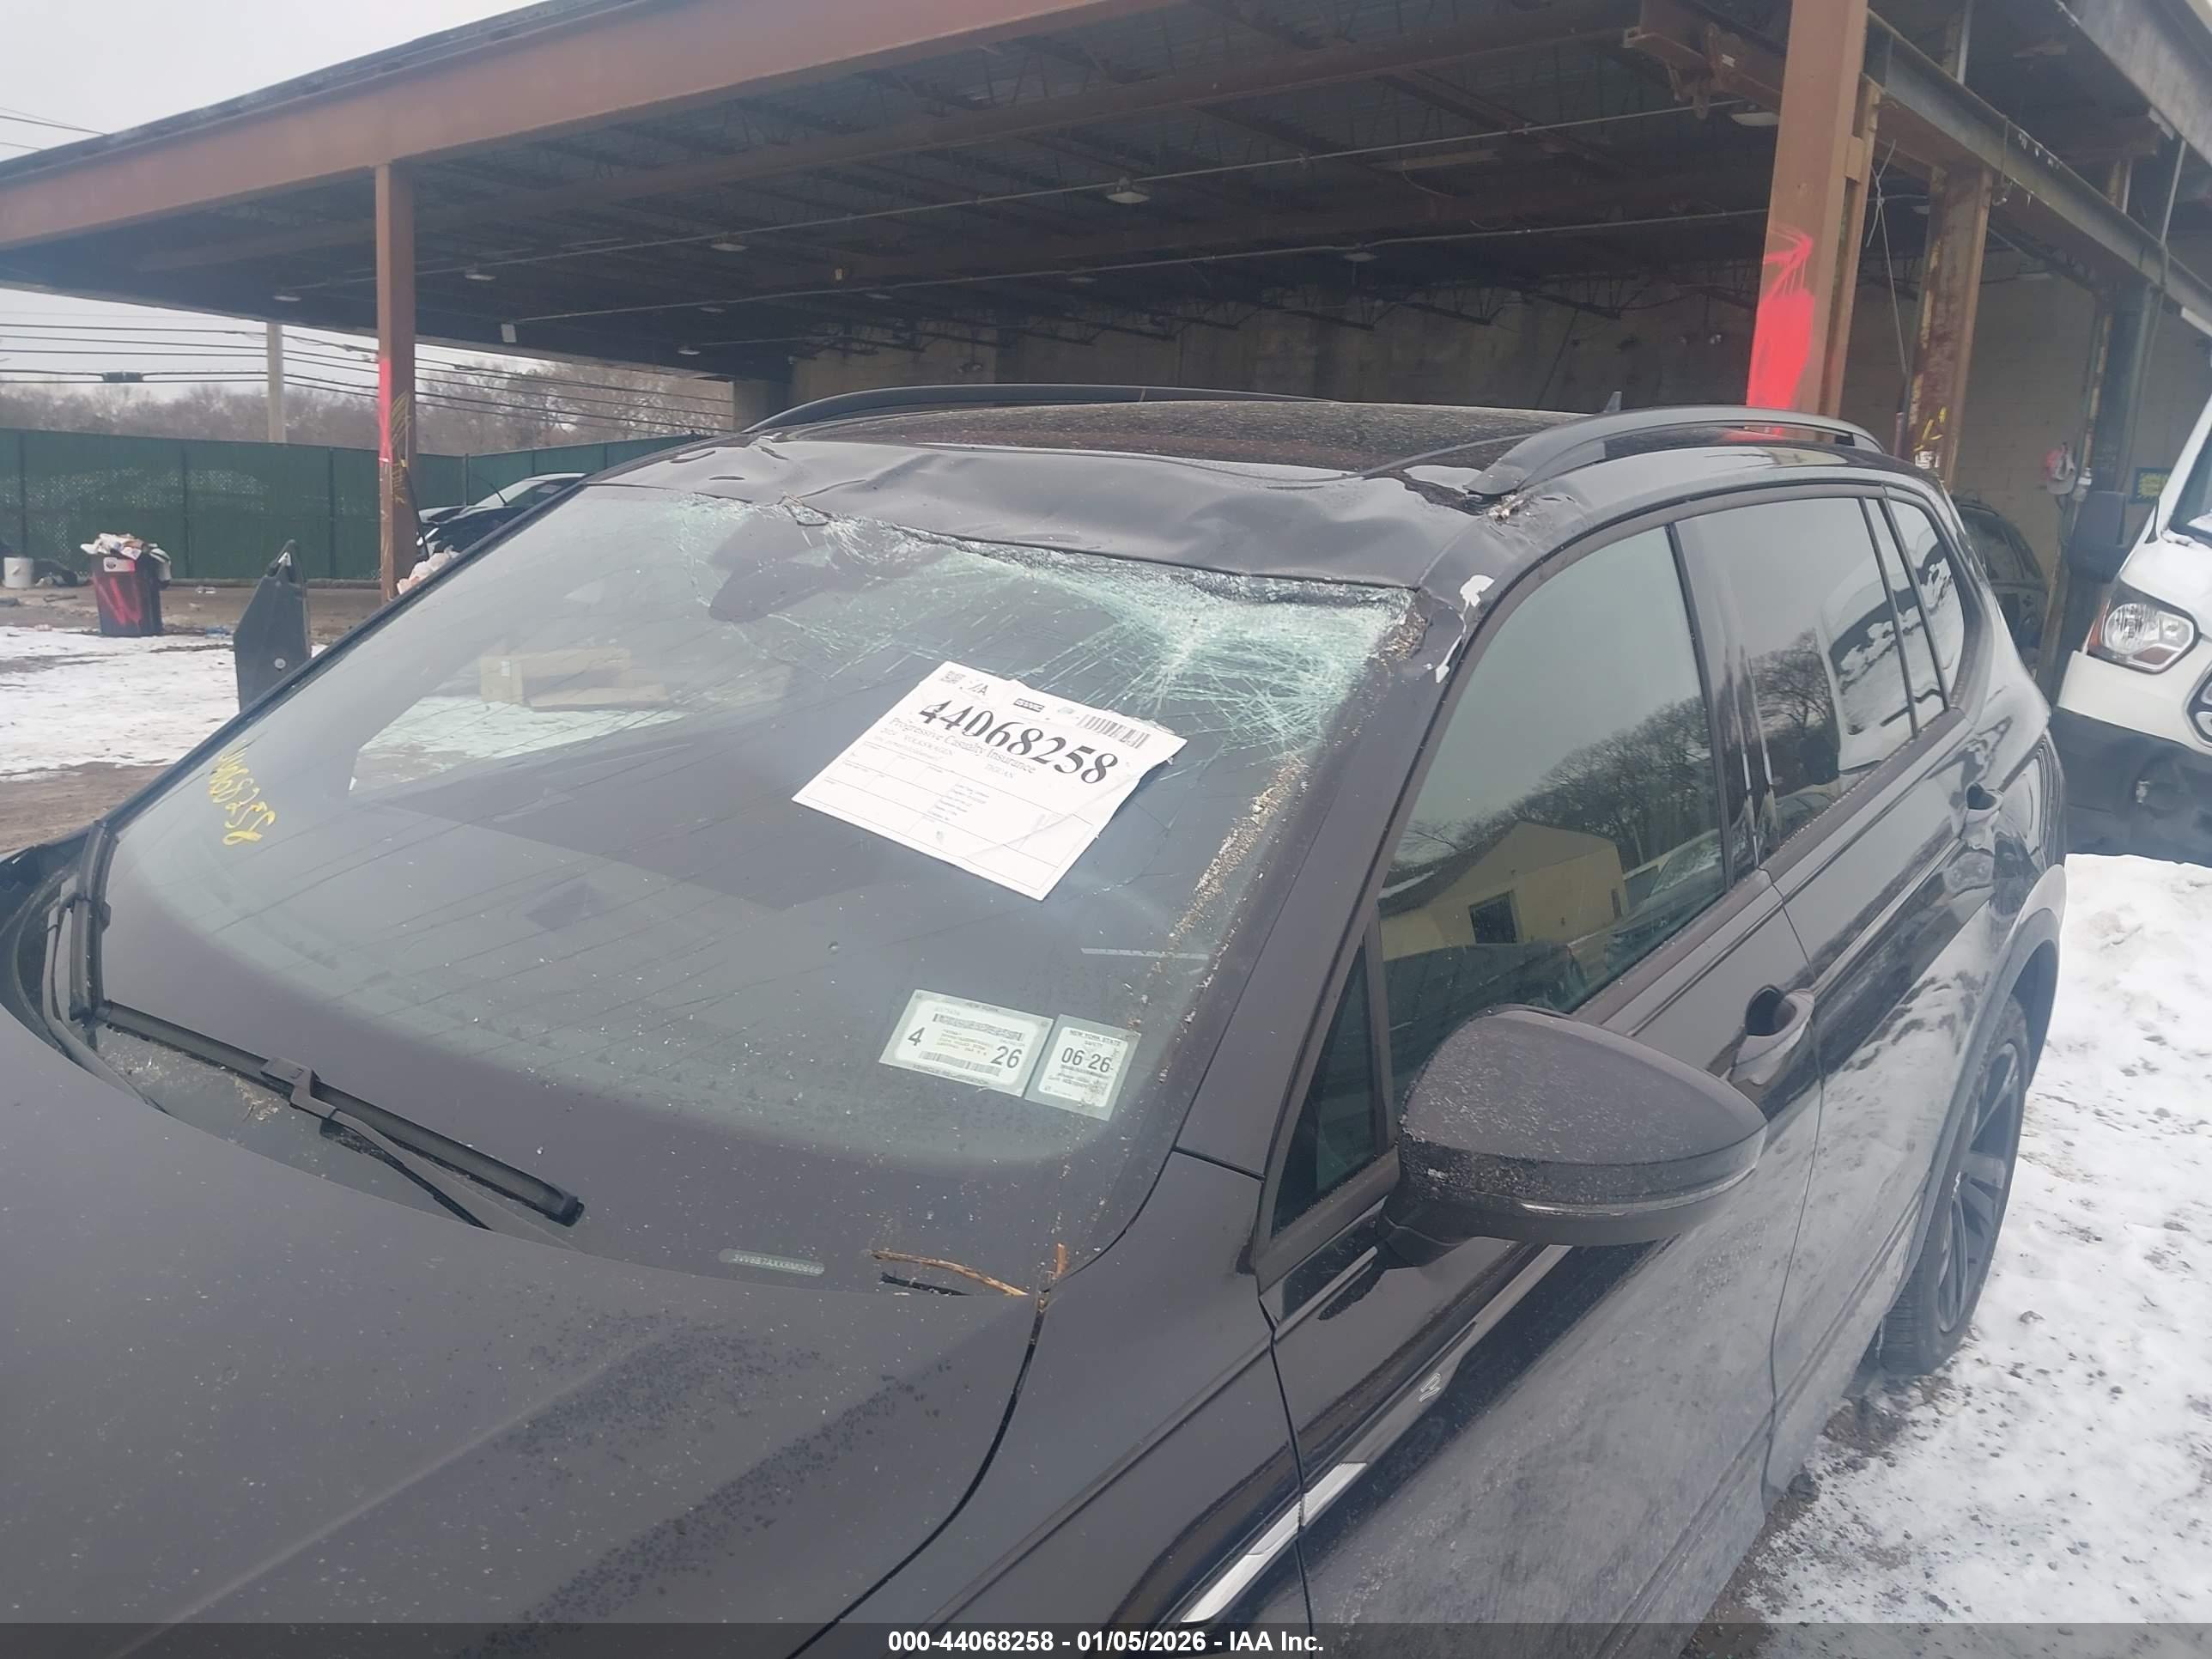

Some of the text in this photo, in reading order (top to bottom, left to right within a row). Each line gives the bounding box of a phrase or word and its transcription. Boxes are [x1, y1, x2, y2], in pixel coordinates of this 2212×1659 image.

[889, 717, 945, 741] Progressive
[944, 735, 986, 757] Casualty
[987, 748, 1036, 774] Insurance
[919, 700, 1119, 785] 44068258
[908, 1026, 926, 1047] 4
[990, 1045, 1023, 1069] 26
